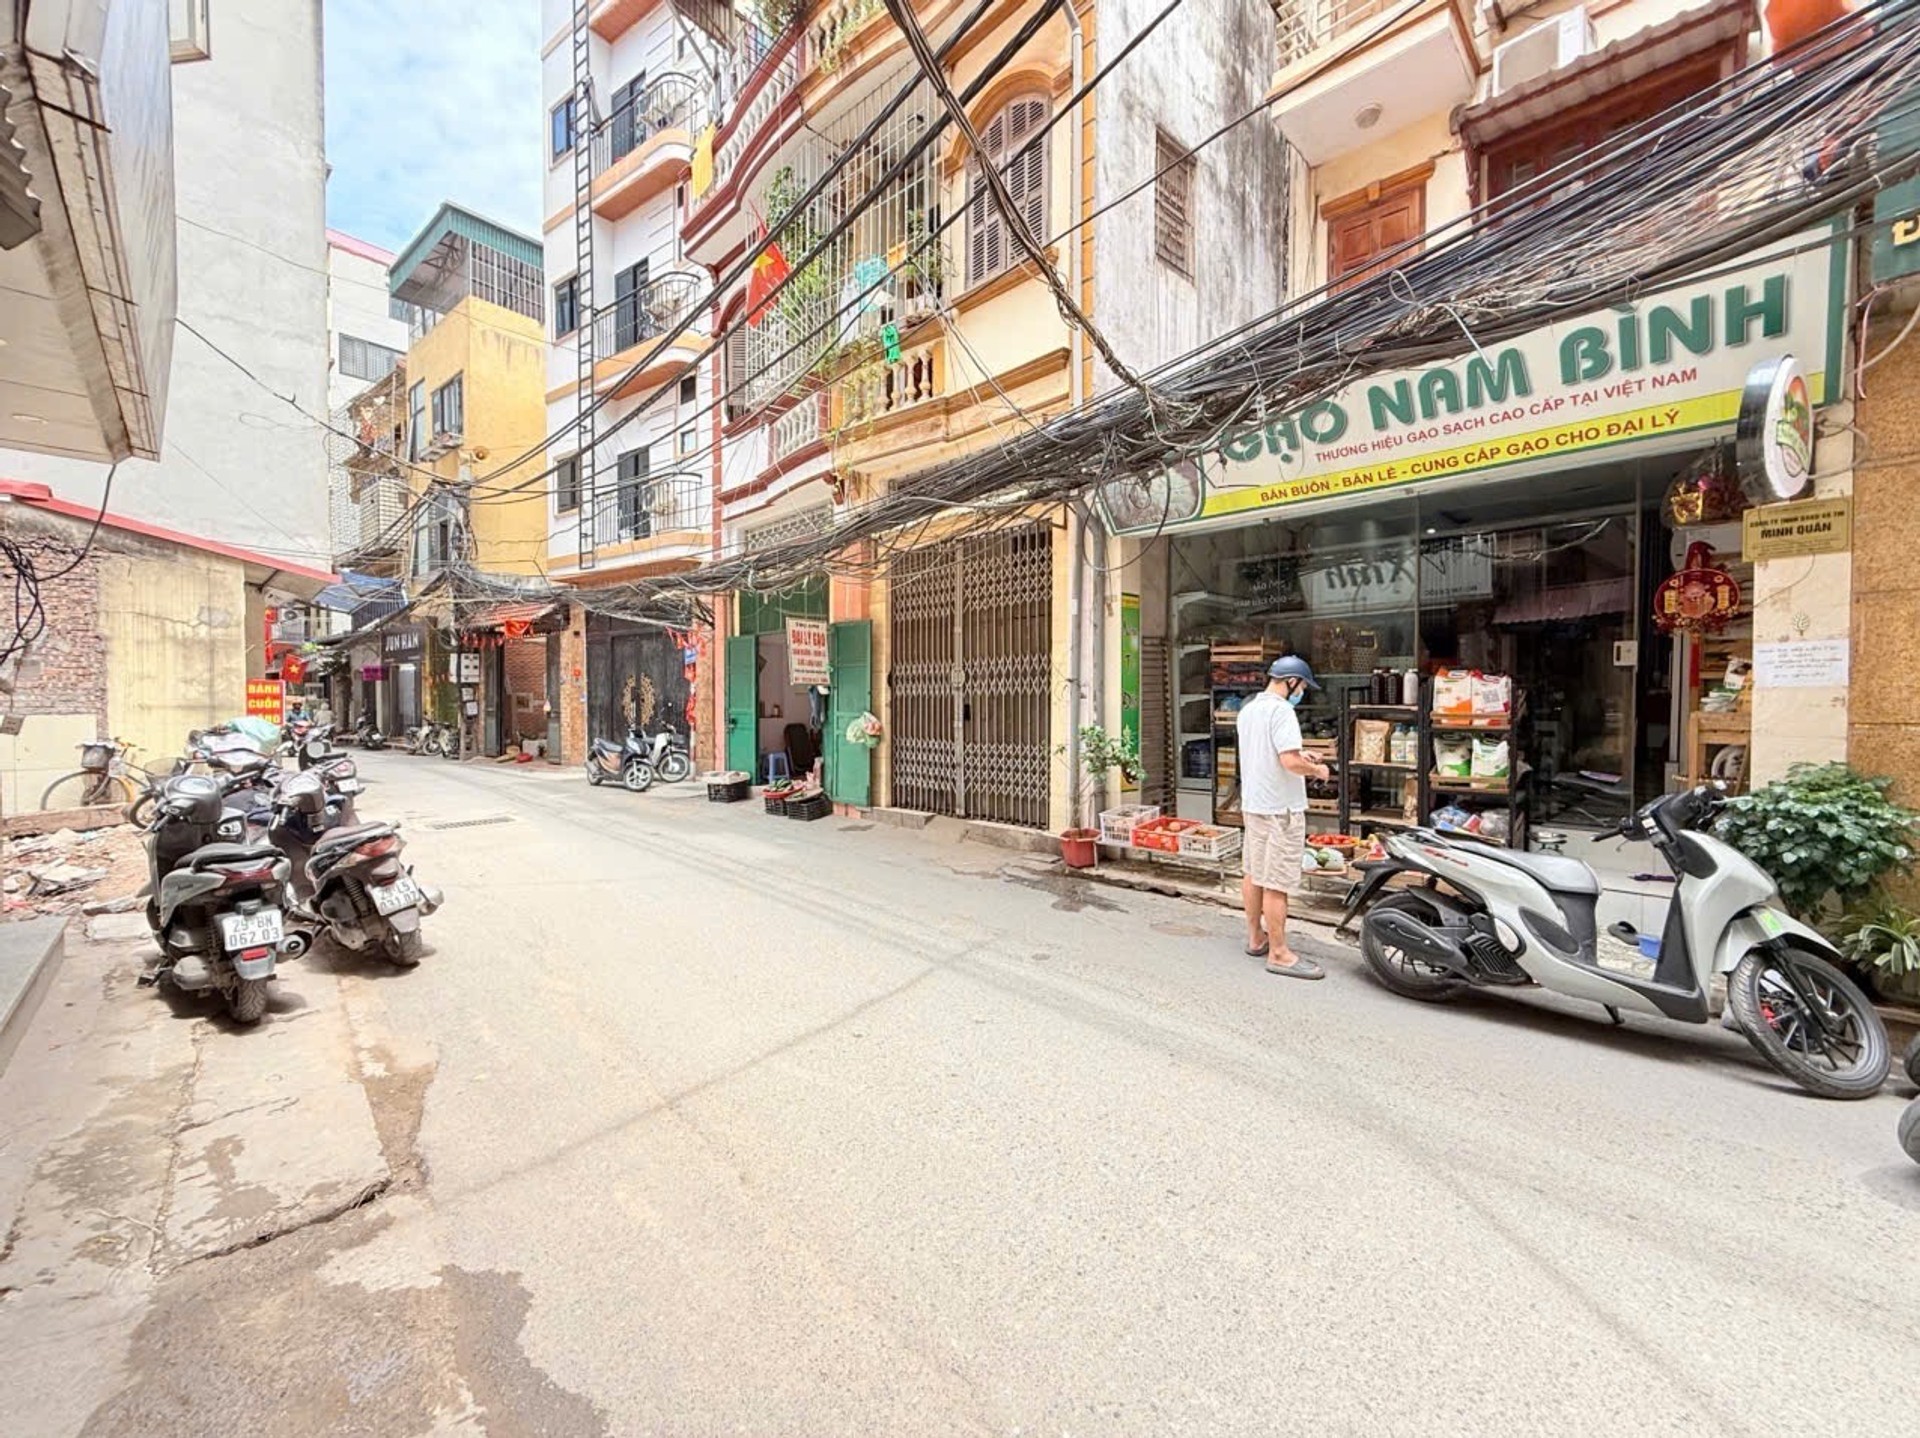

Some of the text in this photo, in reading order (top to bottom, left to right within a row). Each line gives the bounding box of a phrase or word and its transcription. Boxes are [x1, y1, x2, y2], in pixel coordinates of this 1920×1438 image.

[1367, 347, 1531, 431] NAM
[1559, 274, 1787, 385] BÌNH
[1406, 427, 1439, 444] GẠO
[1443, 416, 1485, 435] SẠCH
[1489, 407, 1525, 425] CAO
[1529, 393, 1565, 415] CẤP
[1569, 390, 1598, 407] TẠI
[1603, 378, 1646, 398] VIỆT
[1651, 368, 1697, 389] NAM
[1260, 486, 1289, 502] BÁN
[1291, 479, 1331, 498] BUÔN
[1342, 469, 1374, 488] BÁN
[1411, 455, 1460, 475] CUNG
[1464, 446, 1501, 464] CẤP
[1506, 437, 1550, 456] GẠO
[1555, 427, 1601, 447] CHO
[1606, 417, 1644, 436] ĐẠI
[1651, 408, 1680, 429] LÝ
